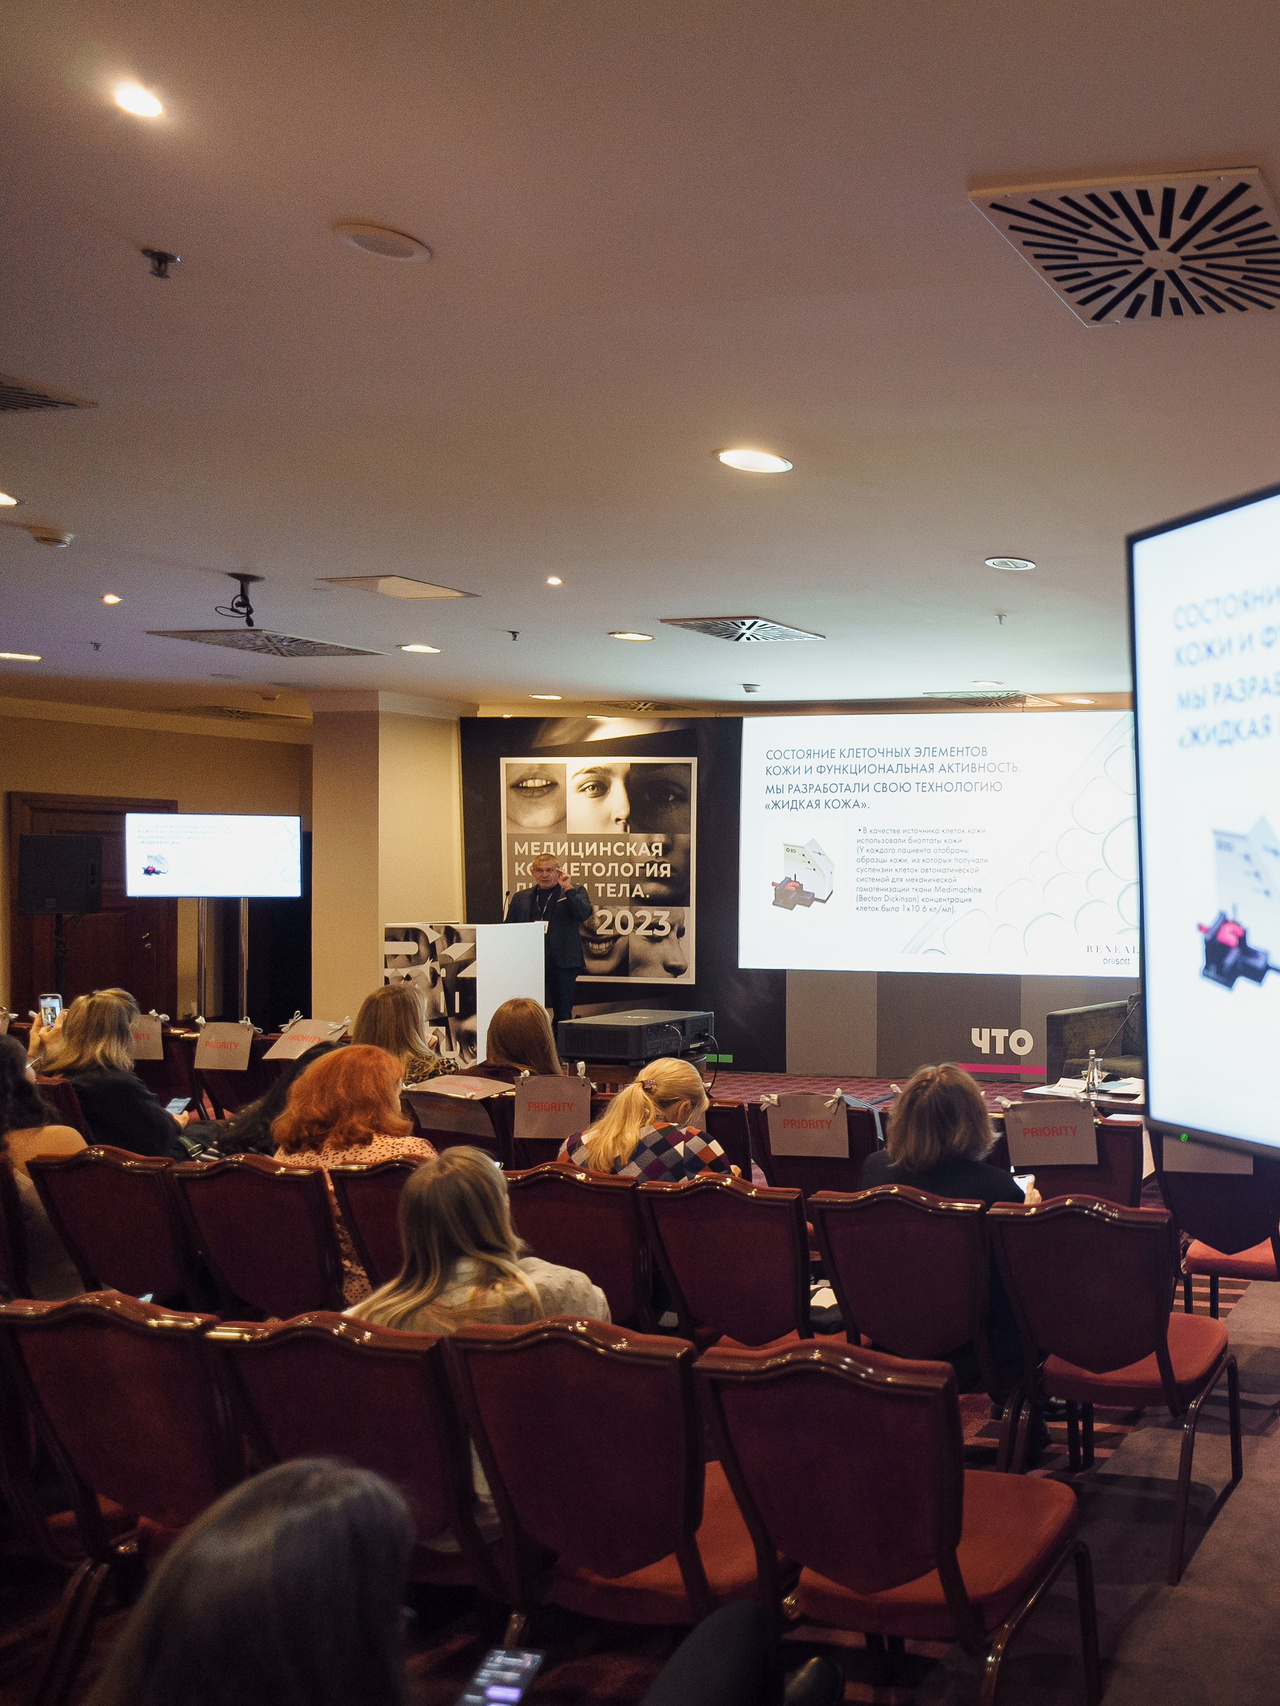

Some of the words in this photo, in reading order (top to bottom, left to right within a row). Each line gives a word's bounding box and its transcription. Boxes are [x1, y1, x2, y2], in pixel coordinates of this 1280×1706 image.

[766, 749, 836, 760] СОСТОЯНИЕ
[840, 747, 910, 758] КЛЕТОЧНЫХ
[914, 746, 988, 758] ЭЛЕМЕНТОВ
[766, 766, 800, 776] КОЖИ
[804, 765, 812, 775] И
[816, 764, 934, 776] ФУНКЦИОНАЛЬНАЯ
[938, 762, 1021, 773] АКТИВНОСТЬ.
[765, 784, 784, 794] МЫ
[788, 783, 870, 793] РАЗРАБОТАЛИ
[874, 782, 912, 793] СВОЮ
[916, 781, 1002, 792] ТЕХНОЛОГИЮ
[765, 800, 820, 811] «ЖИДКАЯ
[824, 799, 870, 809] КОЖА».
[908, 836, 942, 844] биоптаты
[515, 842, 663, 858] МЕДИЦИНСКАЯ
[856, 856, 887, 864] образцы
[515, 862, 671, 878] КЕТОЛОГИЯ
[595, 883, 650, 898] ТЕЛА.
[856, 895, 882, 903] (Becton
[884, 895, 920, 903] Dickinson)
[596, 910, 672, 936] 2023
[205, 1042, 239, 1050] PRIORITY
[971, 1027, 1034, 1056] ЧТО
[527, 1100, 574, 1112] PRIORITY
[783, 1118, 832, 1130] PRIORITY
[1022, 1125, 1078, 1139] PRIORITY
